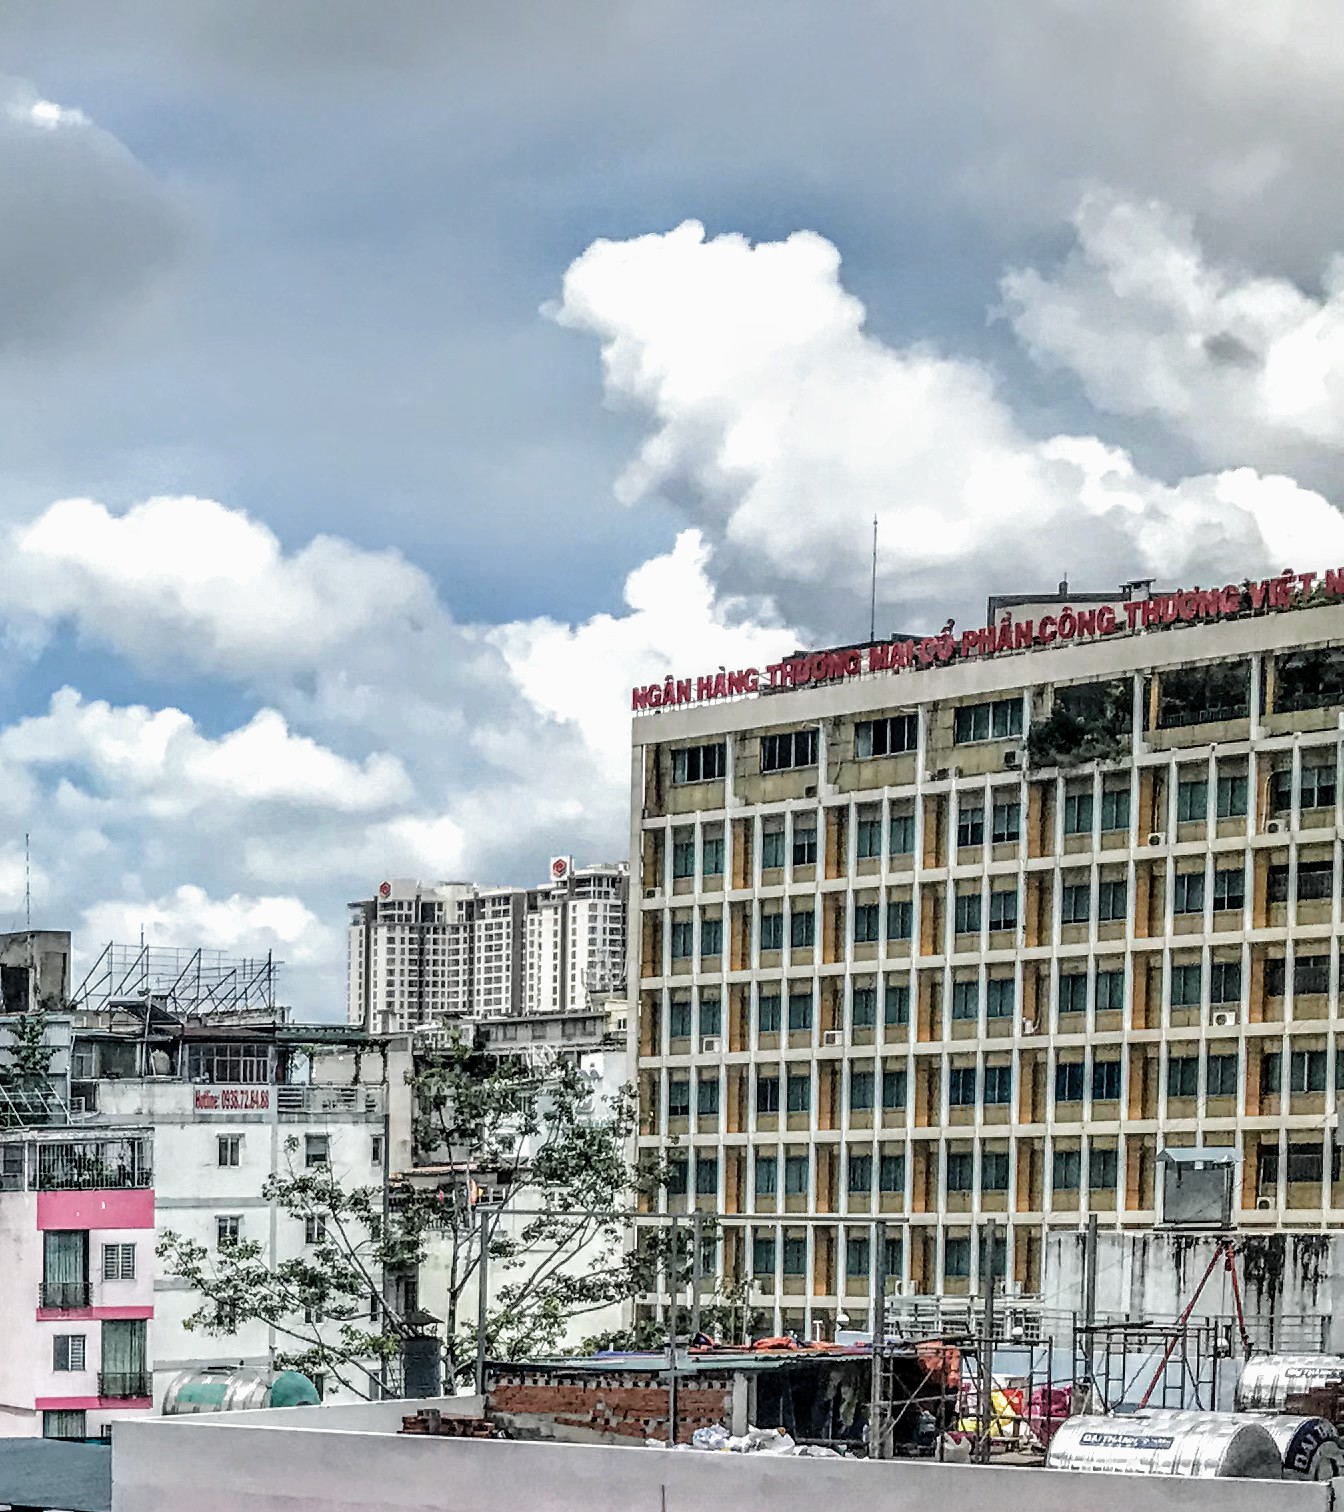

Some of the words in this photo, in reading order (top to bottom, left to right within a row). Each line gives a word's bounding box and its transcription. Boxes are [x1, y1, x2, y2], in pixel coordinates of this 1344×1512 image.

[631, 674, 692, 711] NGÂN
[697, 666, 760, 700] HÀNG
[1039, 605, 1116, 643] CÔNG
[1249, 568, 1317, 610] VIỆT
